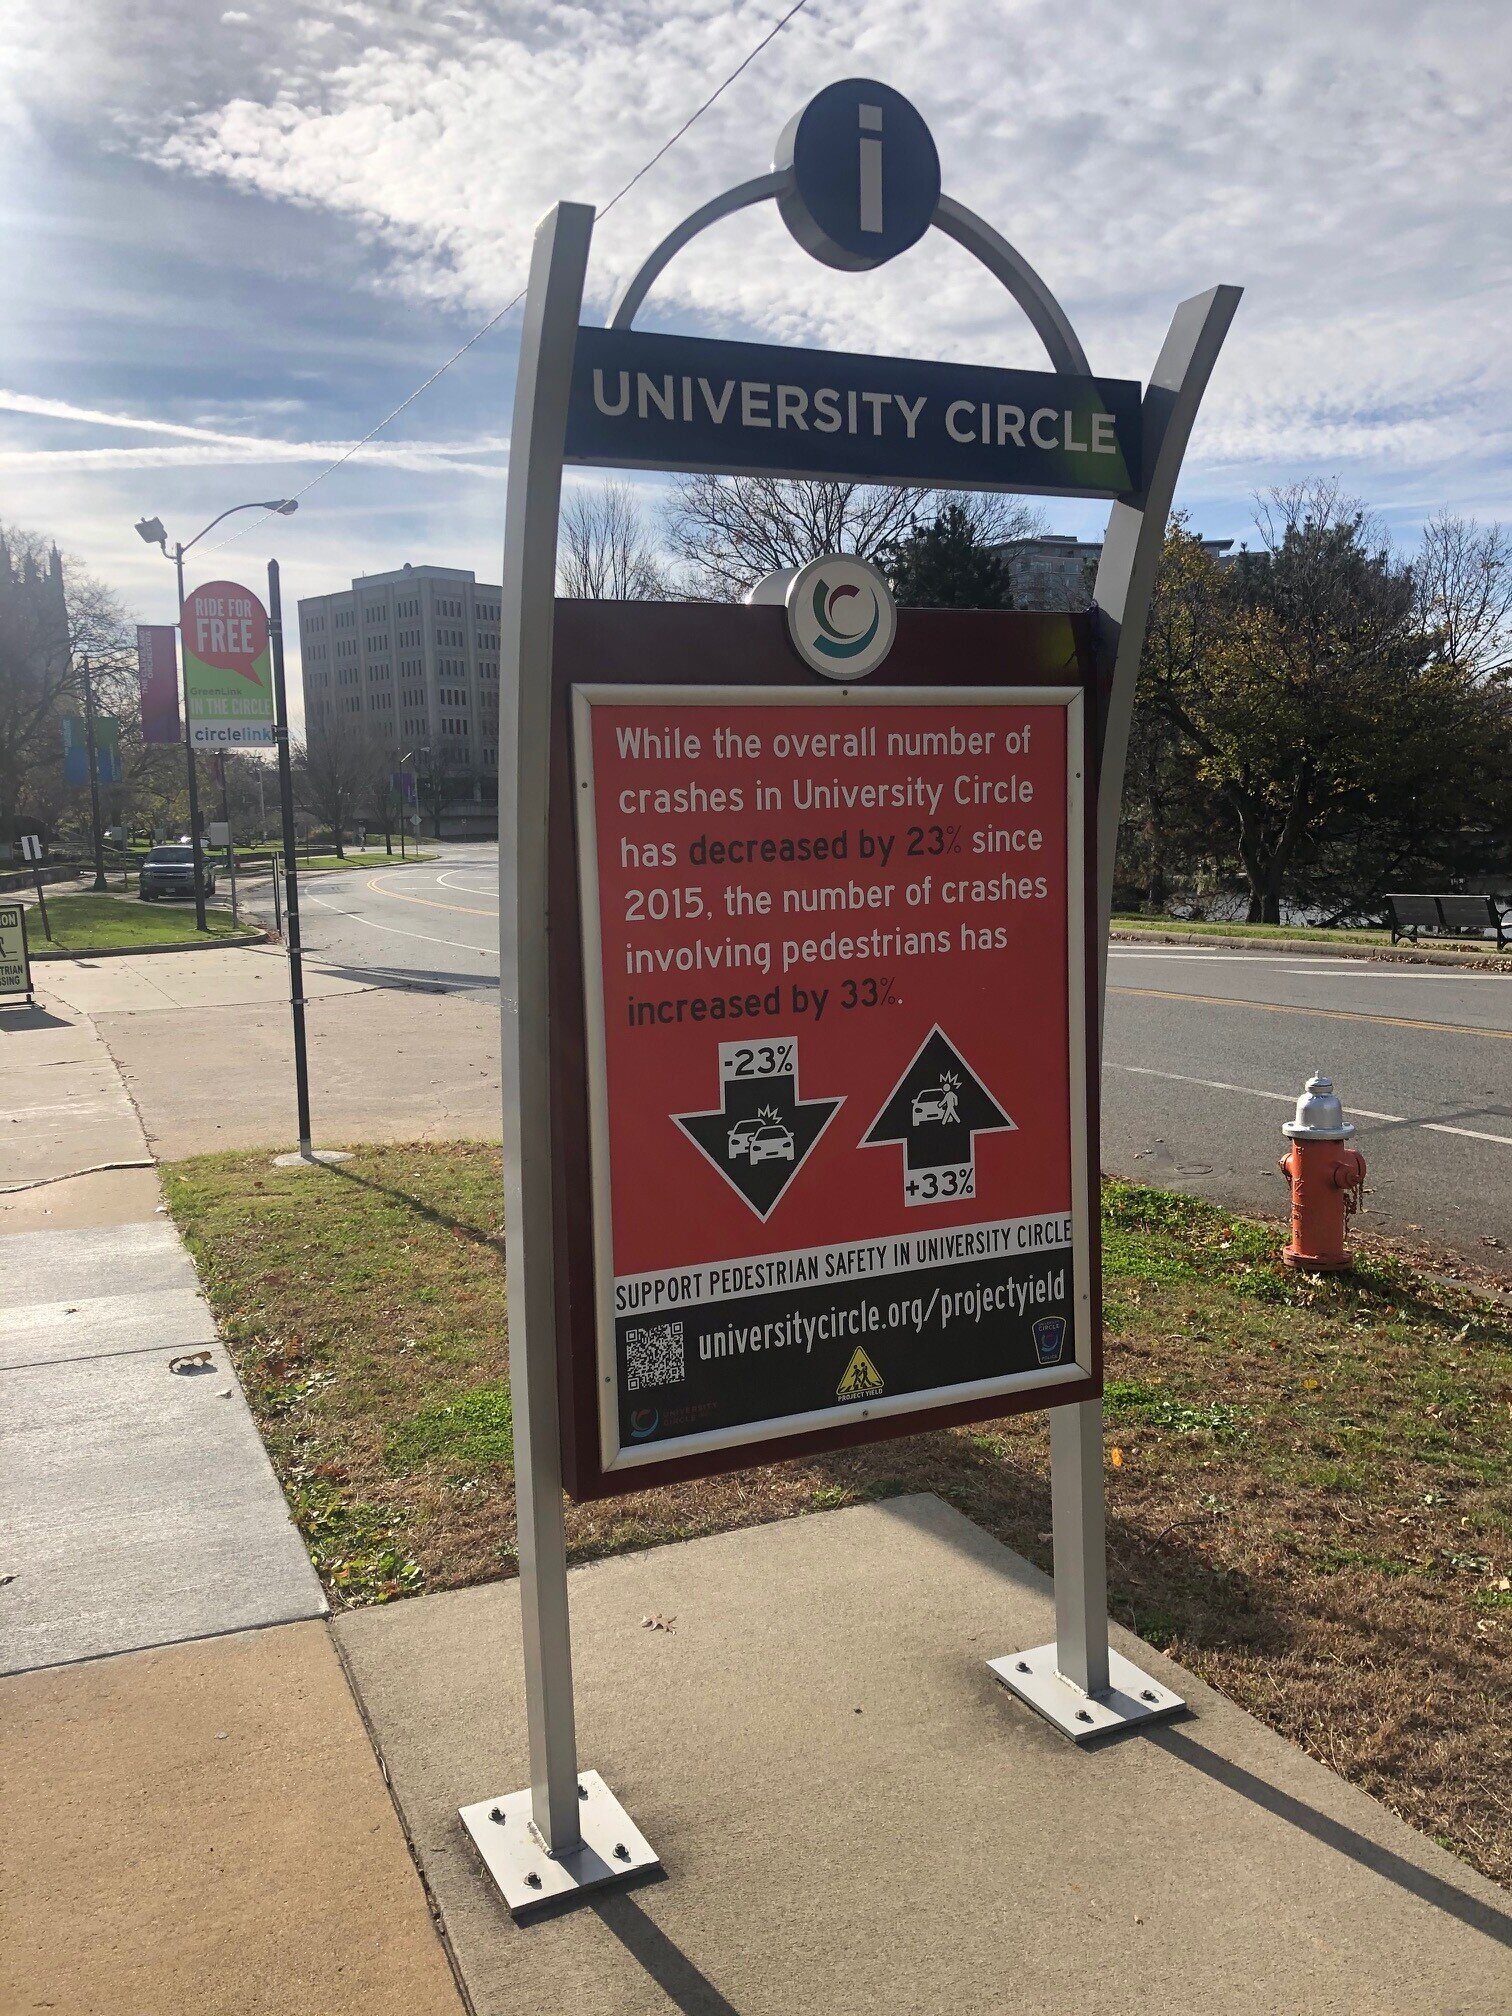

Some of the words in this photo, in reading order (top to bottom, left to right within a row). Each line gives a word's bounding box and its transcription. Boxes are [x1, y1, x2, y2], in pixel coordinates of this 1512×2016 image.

[858, 103, 882, 233] i
[593, 368, 927, 439] UNIVERSITY
[944, 400, 1117, 455] CIRCLE
[195, 598, 224, 617] RIDE
[228, 599, 253, 617] FOR
[196, 618, 255, 653] FREE
[190, 687, 242, 696] GreenLink
[190, 699, 203, 715] IN
[208, 699, 228, 715] THE
[232, 699, 272, 716] CIRCLE
[195, 726, 273, 741] circlelink
[615, 726, 701, 759] While
[713, 727, 762, 759] the
[773, 726, 876, 759] overall
[887, 725, 996, 757] number
[1005, 724, 1031, 755] of
[618, 781, 744, 815] crashes
[756, 779, 783, 811] in
[792, 775, 944, 816] University
[954, 774, 1034, 804] Circle
[620, 837, 678, 868] has
[689, 829, 848, 866] decreased
[859, 828, 895, 867] by
[906, 825, 963, 857] 23%
[972, 824, 1043, 855] since
[624, 886, 713, 923] 2015,
[724, 885, 772, 917] the
[783, 880, 896, 914] number
[904, 876, 932, 908] of
[941, 871, 1048, 904] crashes
[0, 913, 16, 926] ON
[626, 938, 771, 975] involving
[783, 925, 951, 974] pedestrians
[960, 921, 1008, 952] has
[0, 975, 20, 986] SING
[627, 986, 780, 1027] increased
[791, 983, 830, 1021] by
[840, 976, 904, 1010] 33%.
[724, 1044, 794, 1077] -23%
[906, 1167, 974, 1200] +33%
[616, 1272, 703, 1312] SUPPORT
[709, 1256, 819, 1298] PEDESTRIAN
[825, 1245, 888, 1278] SAFETY
[894, 1242, 911, 1267] IN
[916, 1227, 1012, 1264] UNIVERSITY
[1017, 1218, 1072, 1249] CIRCLE
[699, 1269, 1066, 1361] universitycircle.org/projectyield
[838, 1391, 865, 1402] PROJECT
[866, 1388, 883, 1397] YIELD
